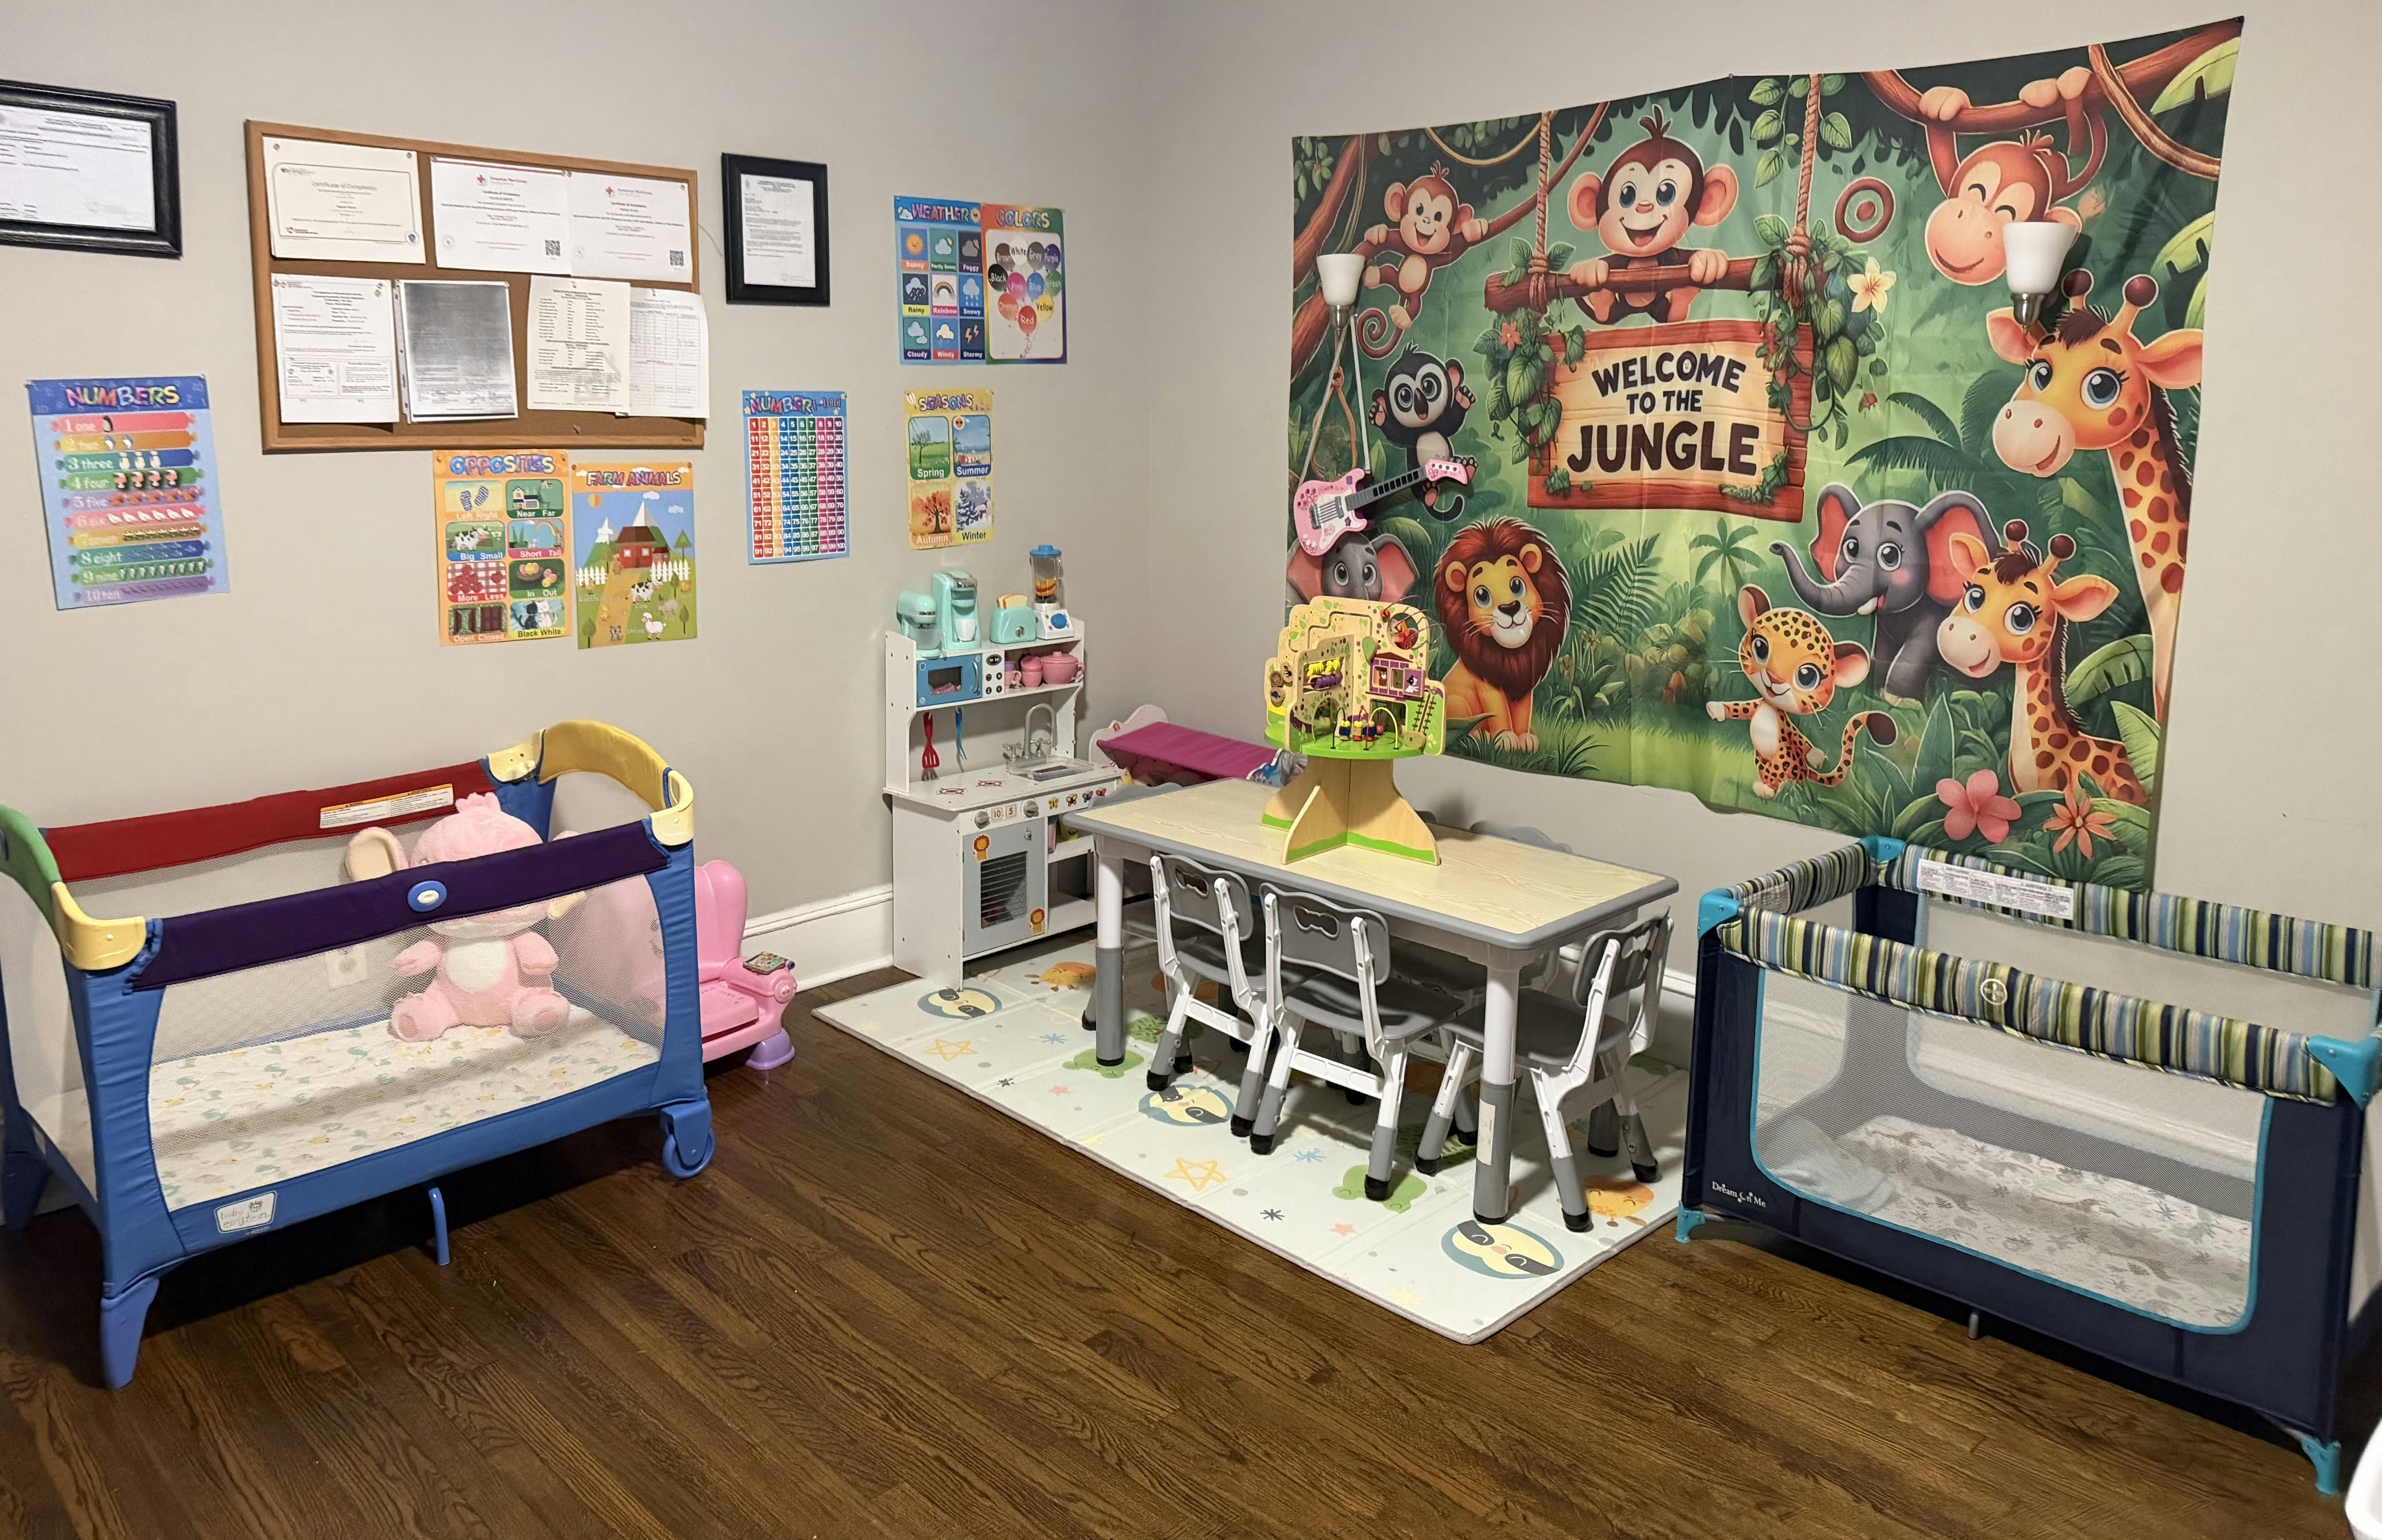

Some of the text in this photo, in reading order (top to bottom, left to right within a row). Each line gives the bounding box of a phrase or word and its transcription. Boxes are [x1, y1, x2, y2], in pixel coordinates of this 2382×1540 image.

[912, 203, 970, 222] WEATHER
[995, 209, 1050, 228] COLORS
[1010, 246, 1026, 255] White
[997, 252, 1012, 262] Brown
[1045, 253, 1058, 263] Purple
[991, 273, 1006, 283] Black
[1011, 281, 1024, 291] Pink
[1036, 303, 1053, 311] Yellow
[1021, 315, 1034, 324] Red
[1592, 351, 1746, 397] WELCOME
[65, 385, 179, 407] NUMBERS
[1627, 390, 1703, 414] TO THE
[749, 396, 812, 415] NUMBER
[918, 394, 974, 411] SEASONS
[66, 419, 95, 432] 1 one
[1567, 421, 1759, 476] JUNGLE
[68, 458, 113, 470] 3 three
[450, 454, 555, 476] OPPOSITES
[917, 469, 944, 478] Spring
[957, 466, 988, 475] Summer
[71, 477, 109, 489] 4 four
[587, 471, 682, 486] FARM ANIMALS
[73, 496, 108, 509] 5 five
[77, 515, 86, 526] 6
[457, 511, 498, 521] Left Right
[917, 535, 948, 544] Autumn
[82, 551, 122, 566] 8 eight
[83, 571, 93, 583] 9
[87, 589, 121, 601] 10 ten
[1712, 1181, 1737, 1198] Dream
[1754, 1196, 1766, 1208] Me
